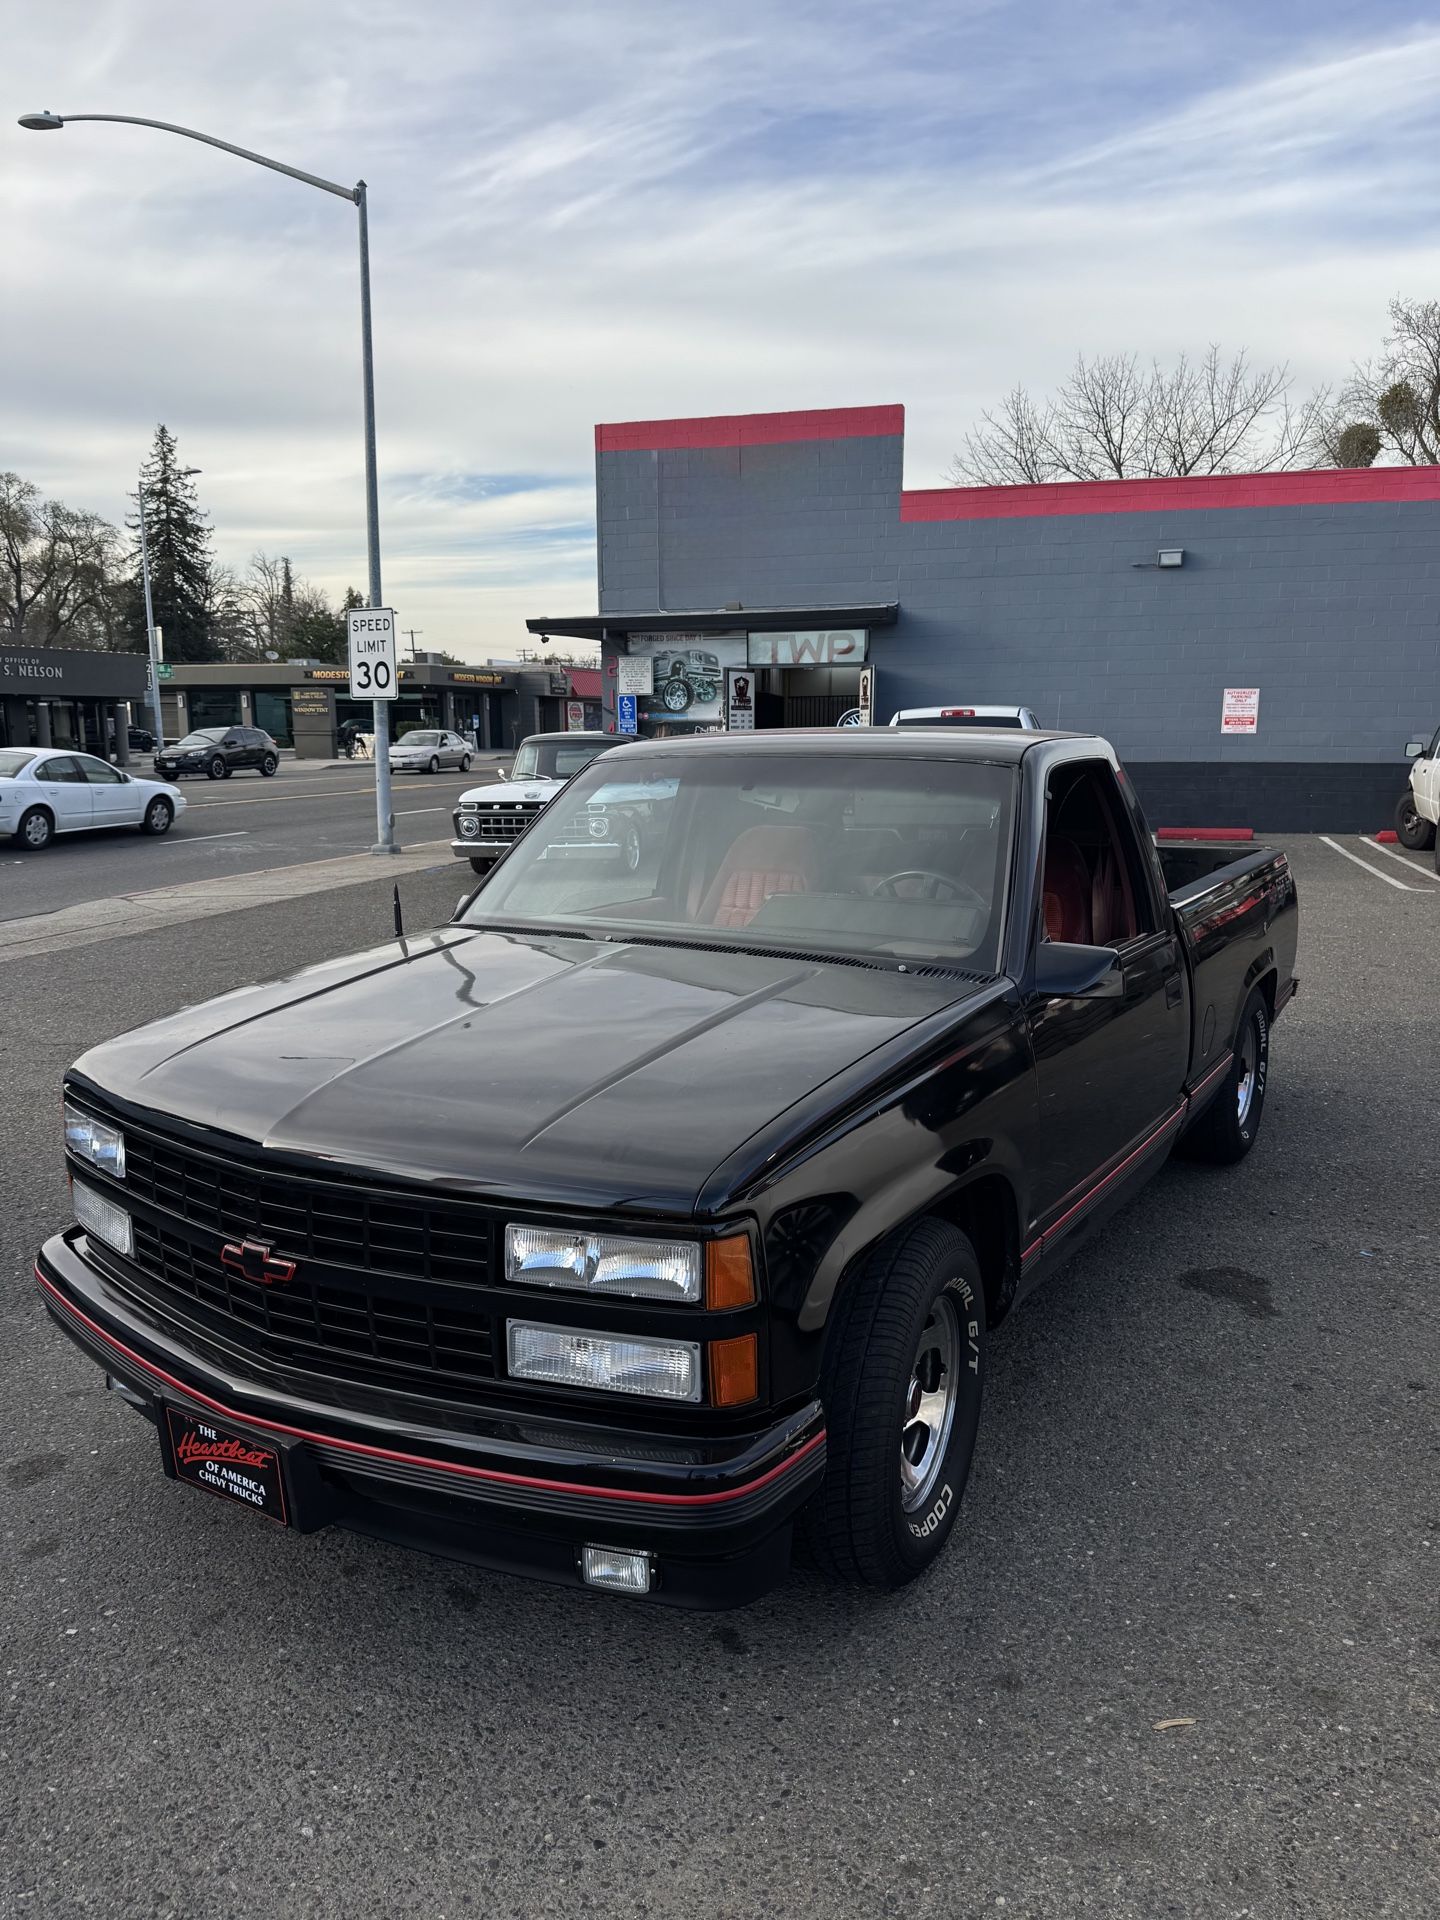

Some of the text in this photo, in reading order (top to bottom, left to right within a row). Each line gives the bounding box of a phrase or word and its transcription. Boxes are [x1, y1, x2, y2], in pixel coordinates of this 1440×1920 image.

[352, 618, 390, 632] SPEED
[357, 639, 387, 653] LIMIT
[761, 632, 856, 664] TWP
[4, 664, 63, 679] S. NELSON
[312, 670, 350, 679] MODESTO
[357, 661, 390, 689] 30
[453, 673, 475, 682] MODESTO
[968, 1320, 980, 1375] G/T
[198, 1424, 218, 1441] THE
[177, 1432, 274, 1468] Heartbeat
[199, 1469, 264, 1506] CHEVY TRUCKS
[205, 1461, 266, 1496] OF AMERICA
